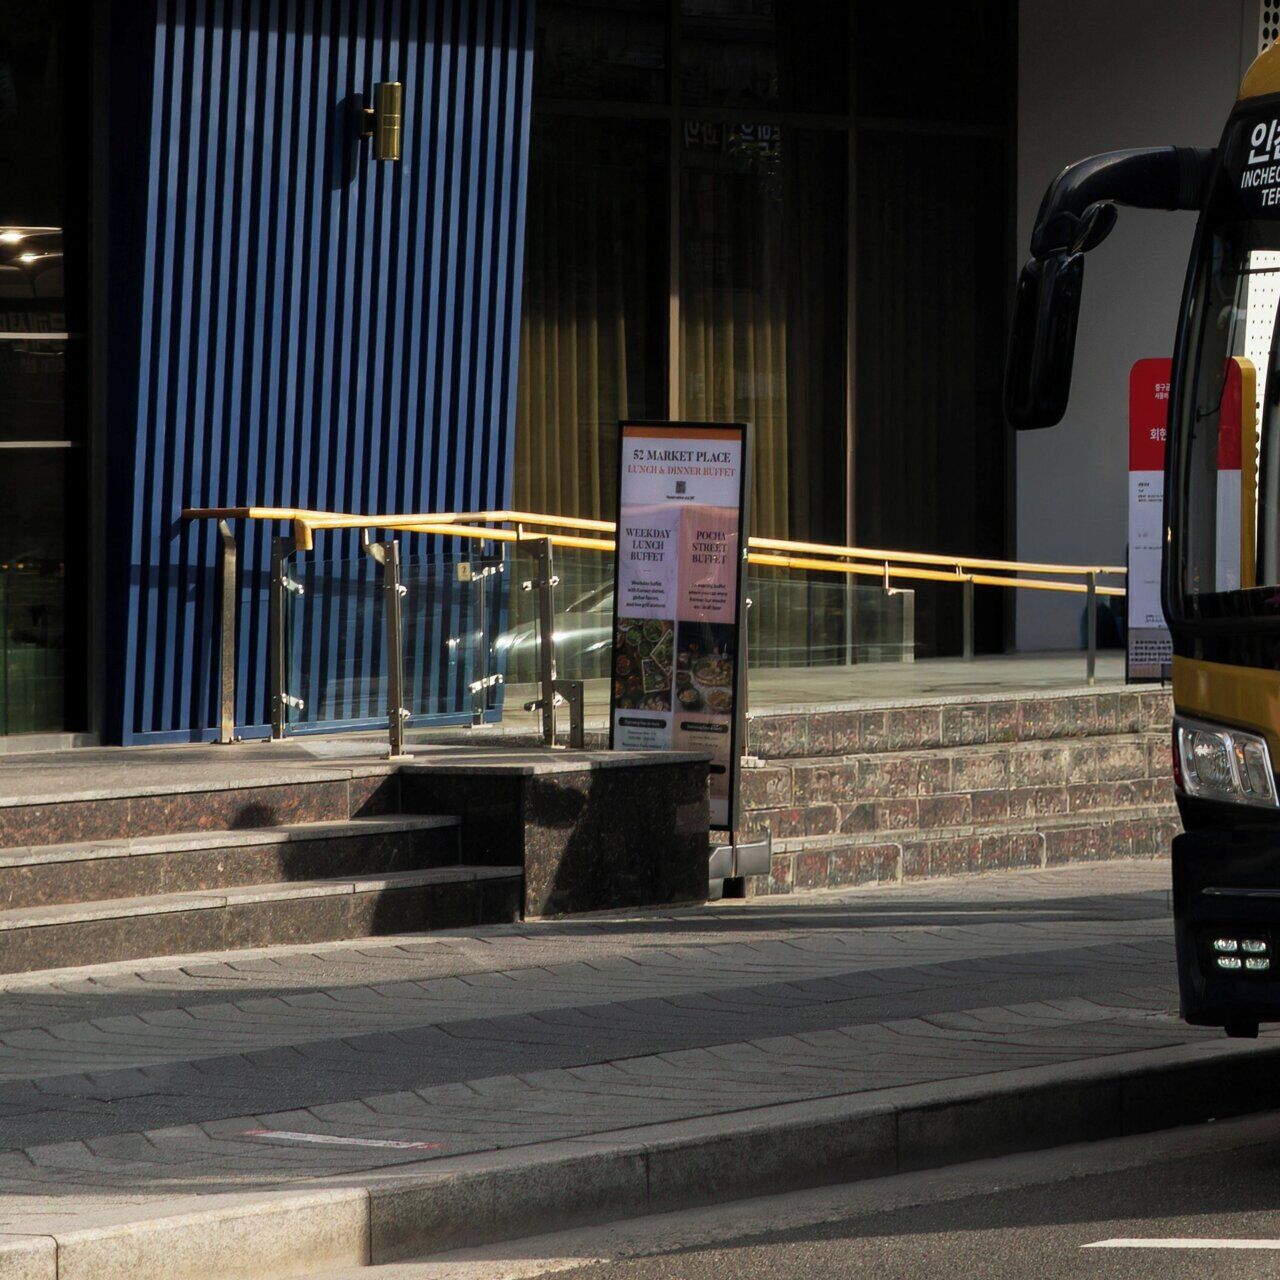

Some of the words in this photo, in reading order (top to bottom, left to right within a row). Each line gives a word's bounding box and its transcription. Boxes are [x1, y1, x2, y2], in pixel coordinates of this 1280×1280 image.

[633, 449, 644, 460] 52
[647, 449, 694, 463] MARKET
[695, 451, 731, 464] PLACE
[627, 464, 658, 475] LUNCH
[658, 466, 665, 475] &
[667, 466, 701, 476] DINNER
[703, 467, 736, 477] BUFFET
[625, 528, 671, 539] WEEKDAY
[696, 530, 726, 541] POCHA
[632, 540, 664, 550] LUNCH
[692, 542, 727, 553] STREET
[630, 552, 665, 562] BUFFET
[692, 554, 727, 565] BUFFET
